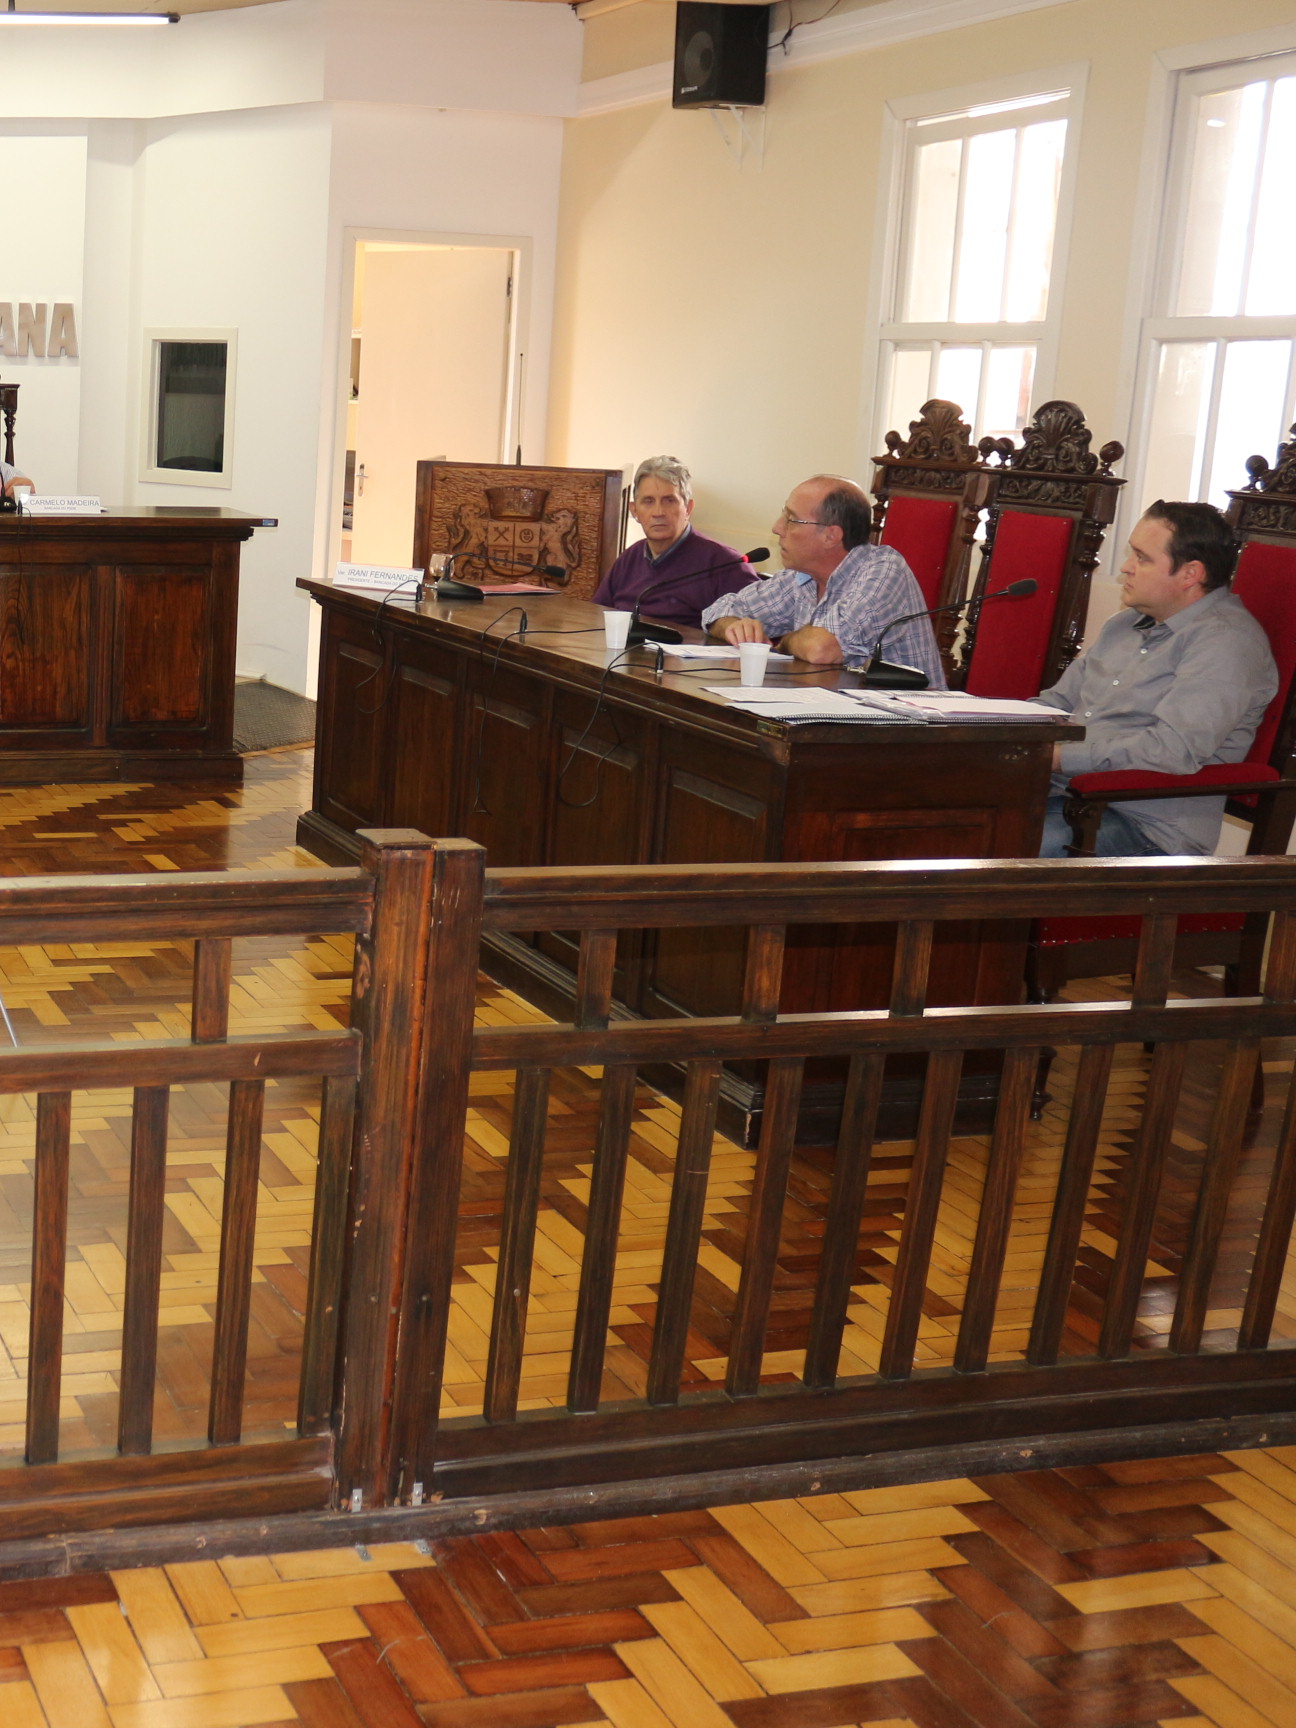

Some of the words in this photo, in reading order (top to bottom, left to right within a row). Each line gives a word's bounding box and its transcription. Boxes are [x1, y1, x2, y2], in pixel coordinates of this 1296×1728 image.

[67, 499, 100, 507] MADEIRA
[347, 568, 368, 577] IRANI
[369, 570, 419, 581] FERNANDES
